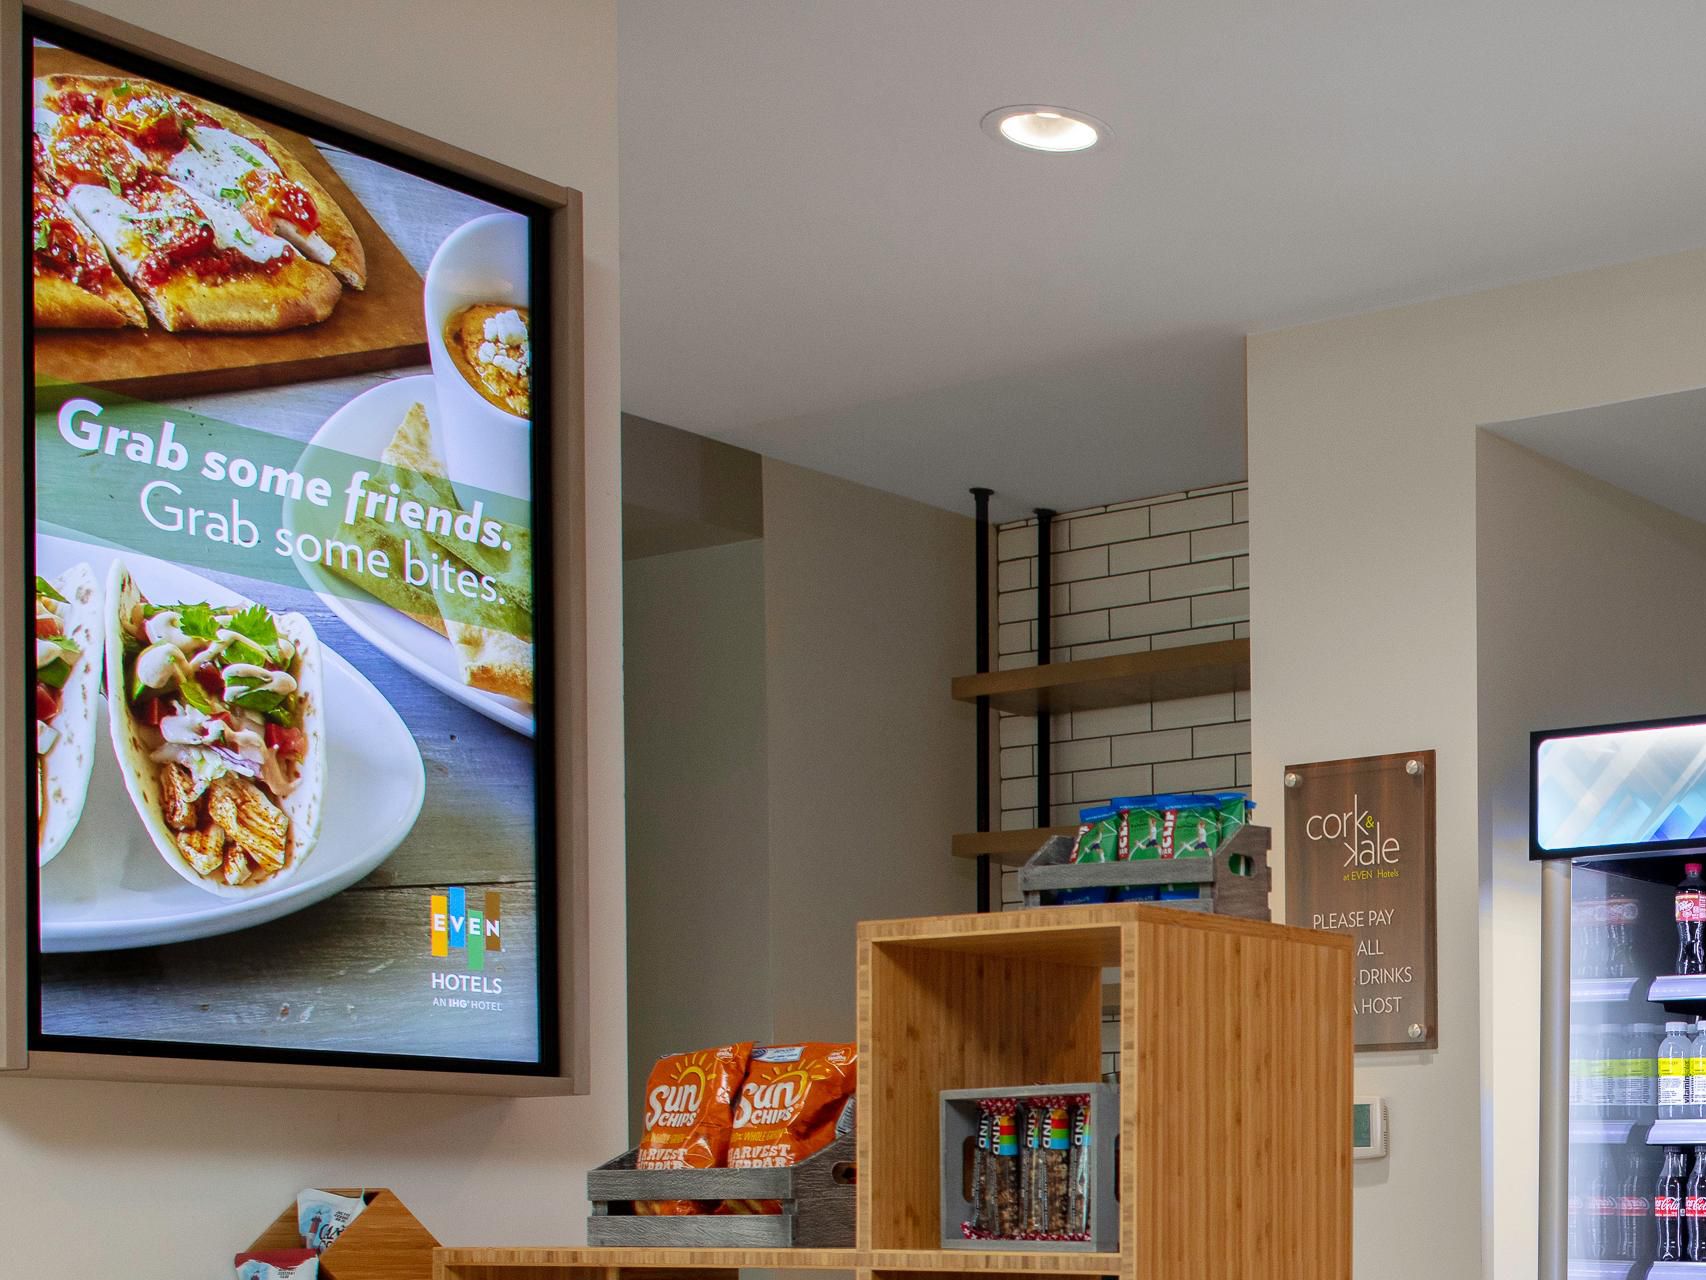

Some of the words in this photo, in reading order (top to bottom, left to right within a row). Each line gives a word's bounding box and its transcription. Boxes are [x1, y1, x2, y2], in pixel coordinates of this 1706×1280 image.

[57, 398, 190, 473] Grab
[200, 451, 332, 507] some
[345, 471, 513, 553] friends.
[139, 480, 260, 549] Grab
[275, 523, 392, 580] some
[403, 541, 507, 606] bites.
[1306, 794, 1369, 841] cork
[1351, 870, 1373, 880] EVEN
[1377, 869, 1399, 879] Hotels
[433, 911, 501, 938] EVEN
[1313, 912, 1364, 929] PLEASE
[1368, 909, 1395, 926] PAY
[1357, 940, 1384, 957] ALL
[431, 972, 502, 994] HOTELS
[1359, 967, 1412, 985] DRINKS
[432, 997, 446, 1007] AN
[471, 1001, 503, 1011] HOTEL
[1362, 997, 1402, 1014] HOST
[645, 1084, 698, 1131] Sun
[733, 1081, 799, 1129] Sun
[751, 1107, 794, 1125] CHIPS
[658, 1112, 697, 1128] CHIPS
[1027, 1108, 1038, 1147] KIND
[1042, 1107, 1053, 1148] KIND
[1075, 1106, 1086, 1146] KIND
[993, 1116, 1001, 1155] KIND
